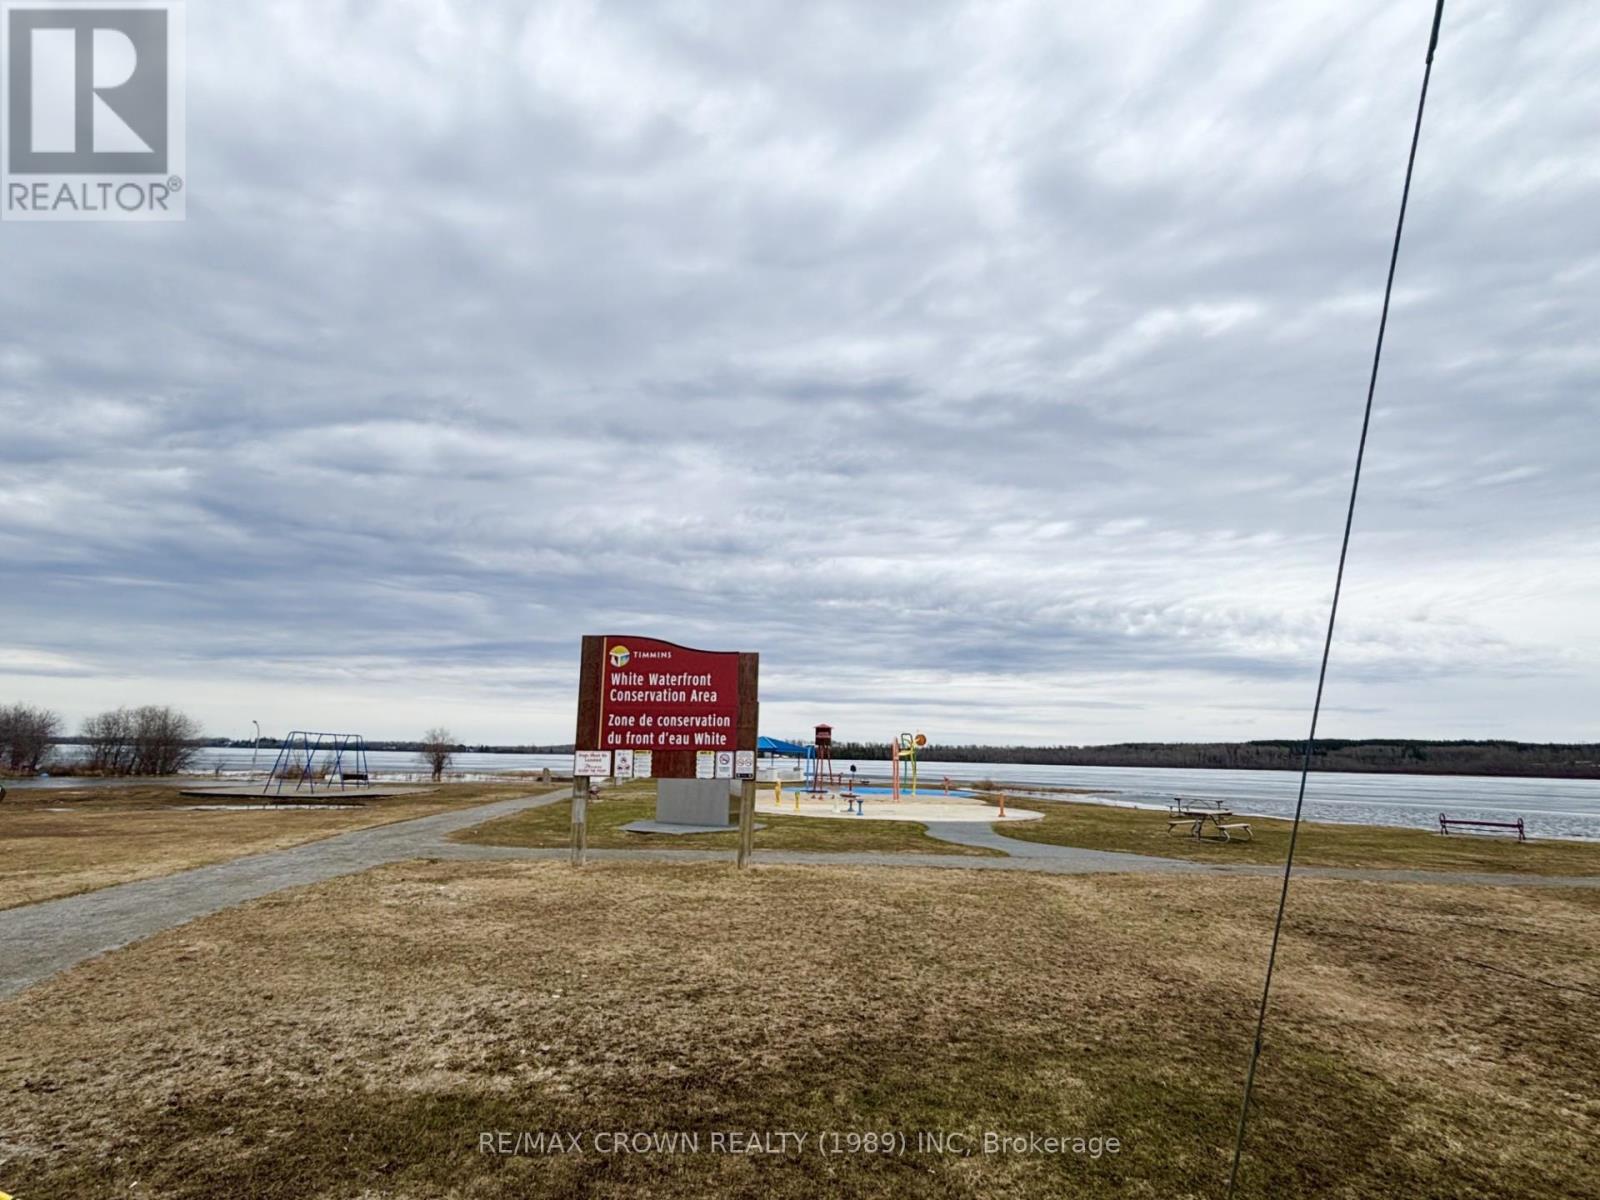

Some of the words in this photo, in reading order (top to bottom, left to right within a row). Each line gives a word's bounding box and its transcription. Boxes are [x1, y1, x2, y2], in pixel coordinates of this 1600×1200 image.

[633, 651, 672, 659] TIMMINS
[611, 672, 644, 686] White
[648, 672, 712, 687] Waterfront
[610, 688, 686, 702] Conservation
[690, 689, 718, 702] Area
[608, 713, 635, 727] Zone
[639, 713, 653, 727] de
[657, 713, 731, 727] conservation
[607, 731, 622, 745] du
[626, 731, 654, 745] front
[658, 731, 690, 745] d'eau
[694, 731, 727, 745] White
